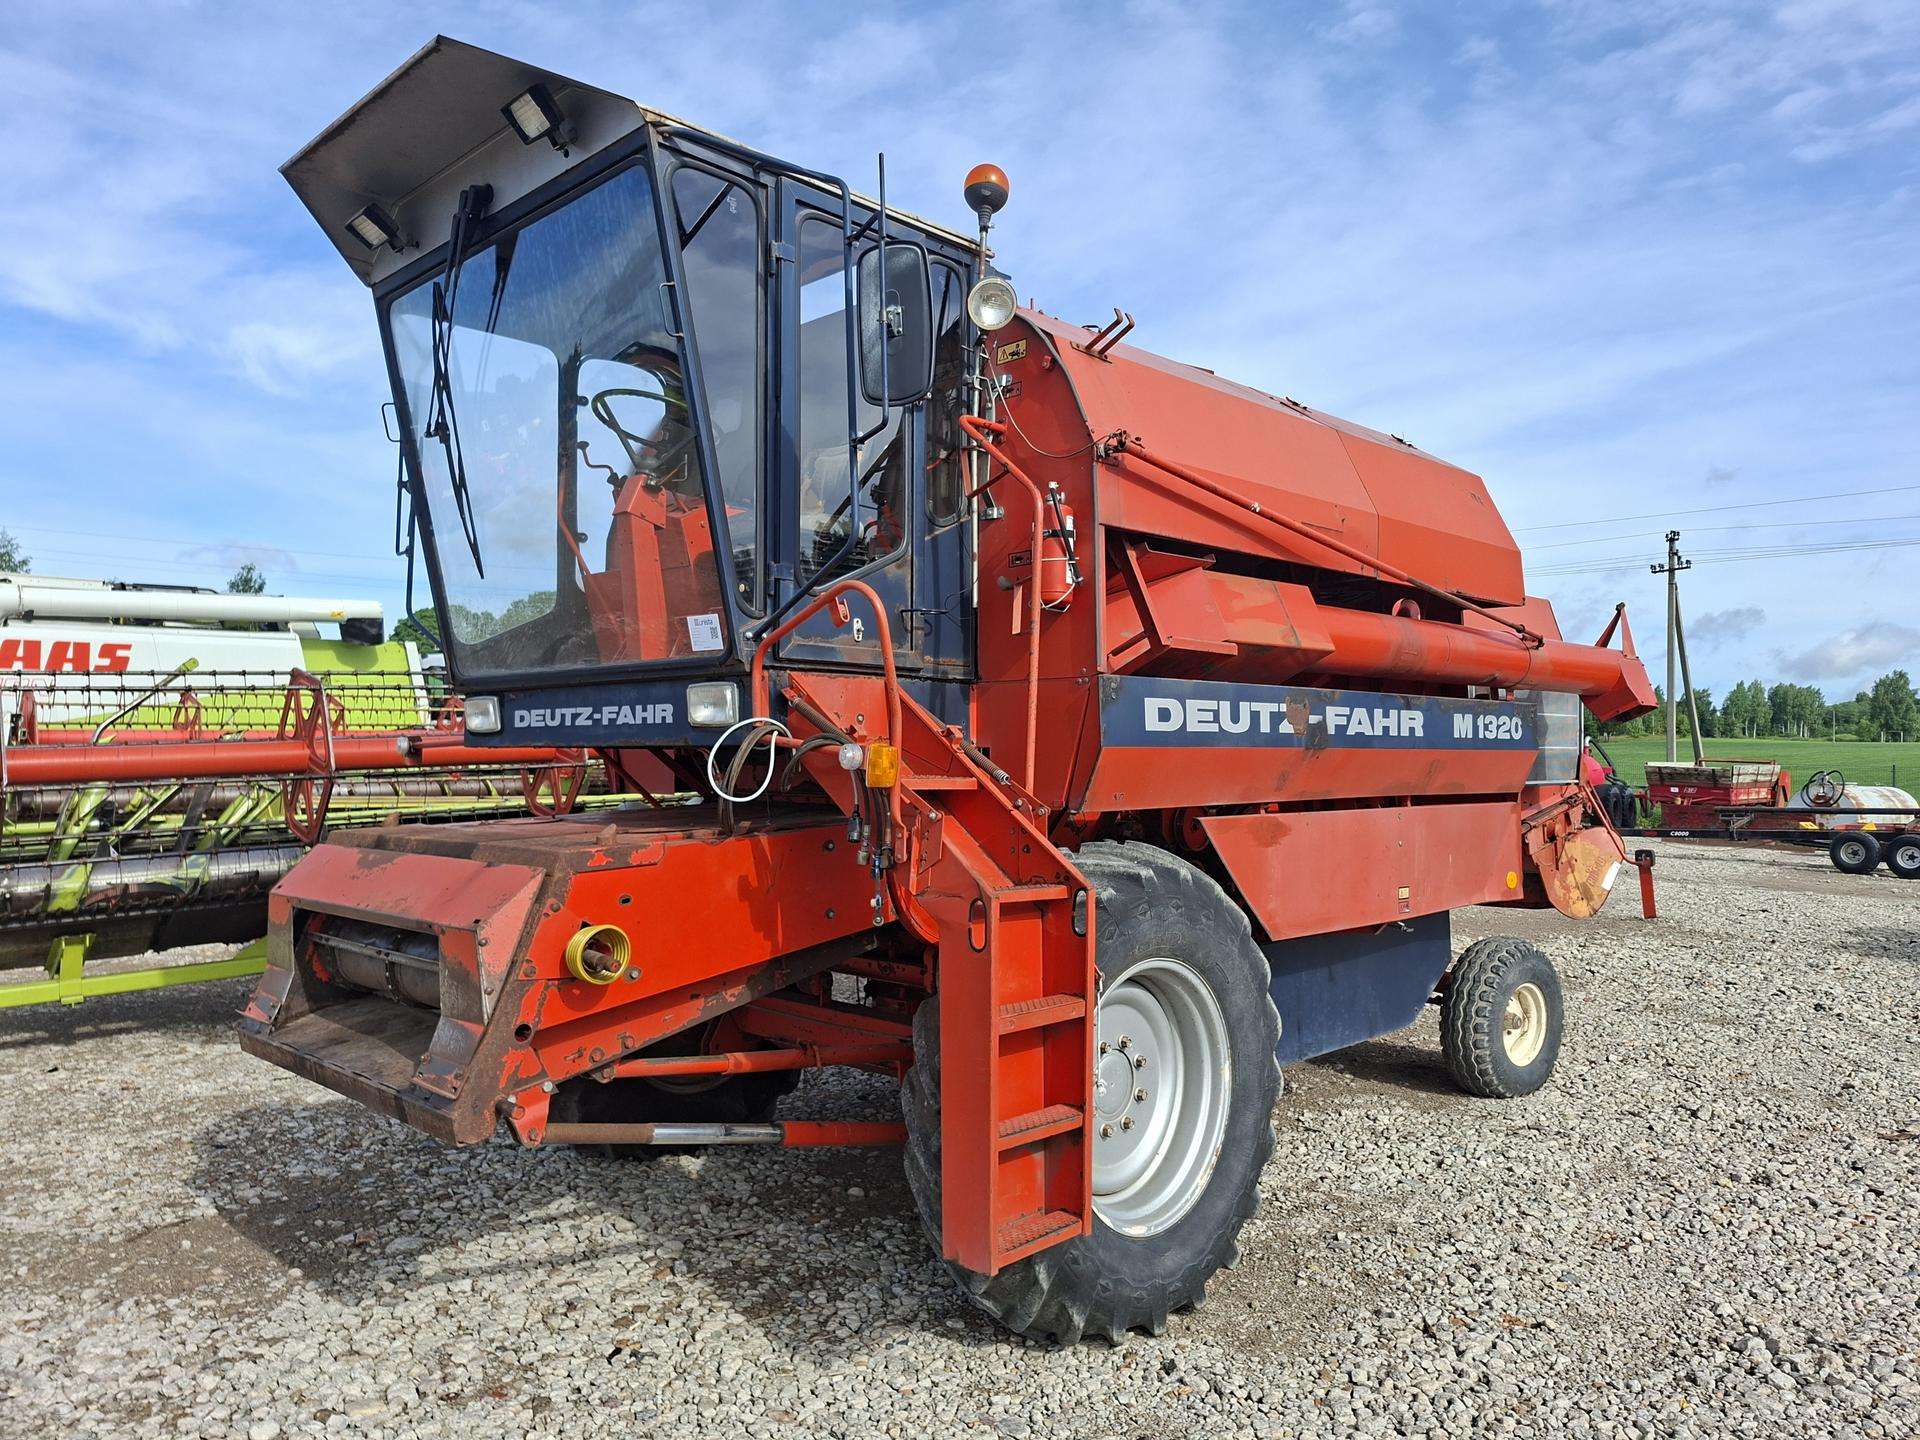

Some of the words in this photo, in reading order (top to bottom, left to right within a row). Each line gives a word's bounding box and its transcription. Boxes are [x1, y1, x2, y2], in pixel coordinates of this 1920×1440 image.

[514, 703, 674, 728] DEUTZ-FAHR
[1453, 713, 1473, 739] M
[1477, 714, 1523, 740] 1320
